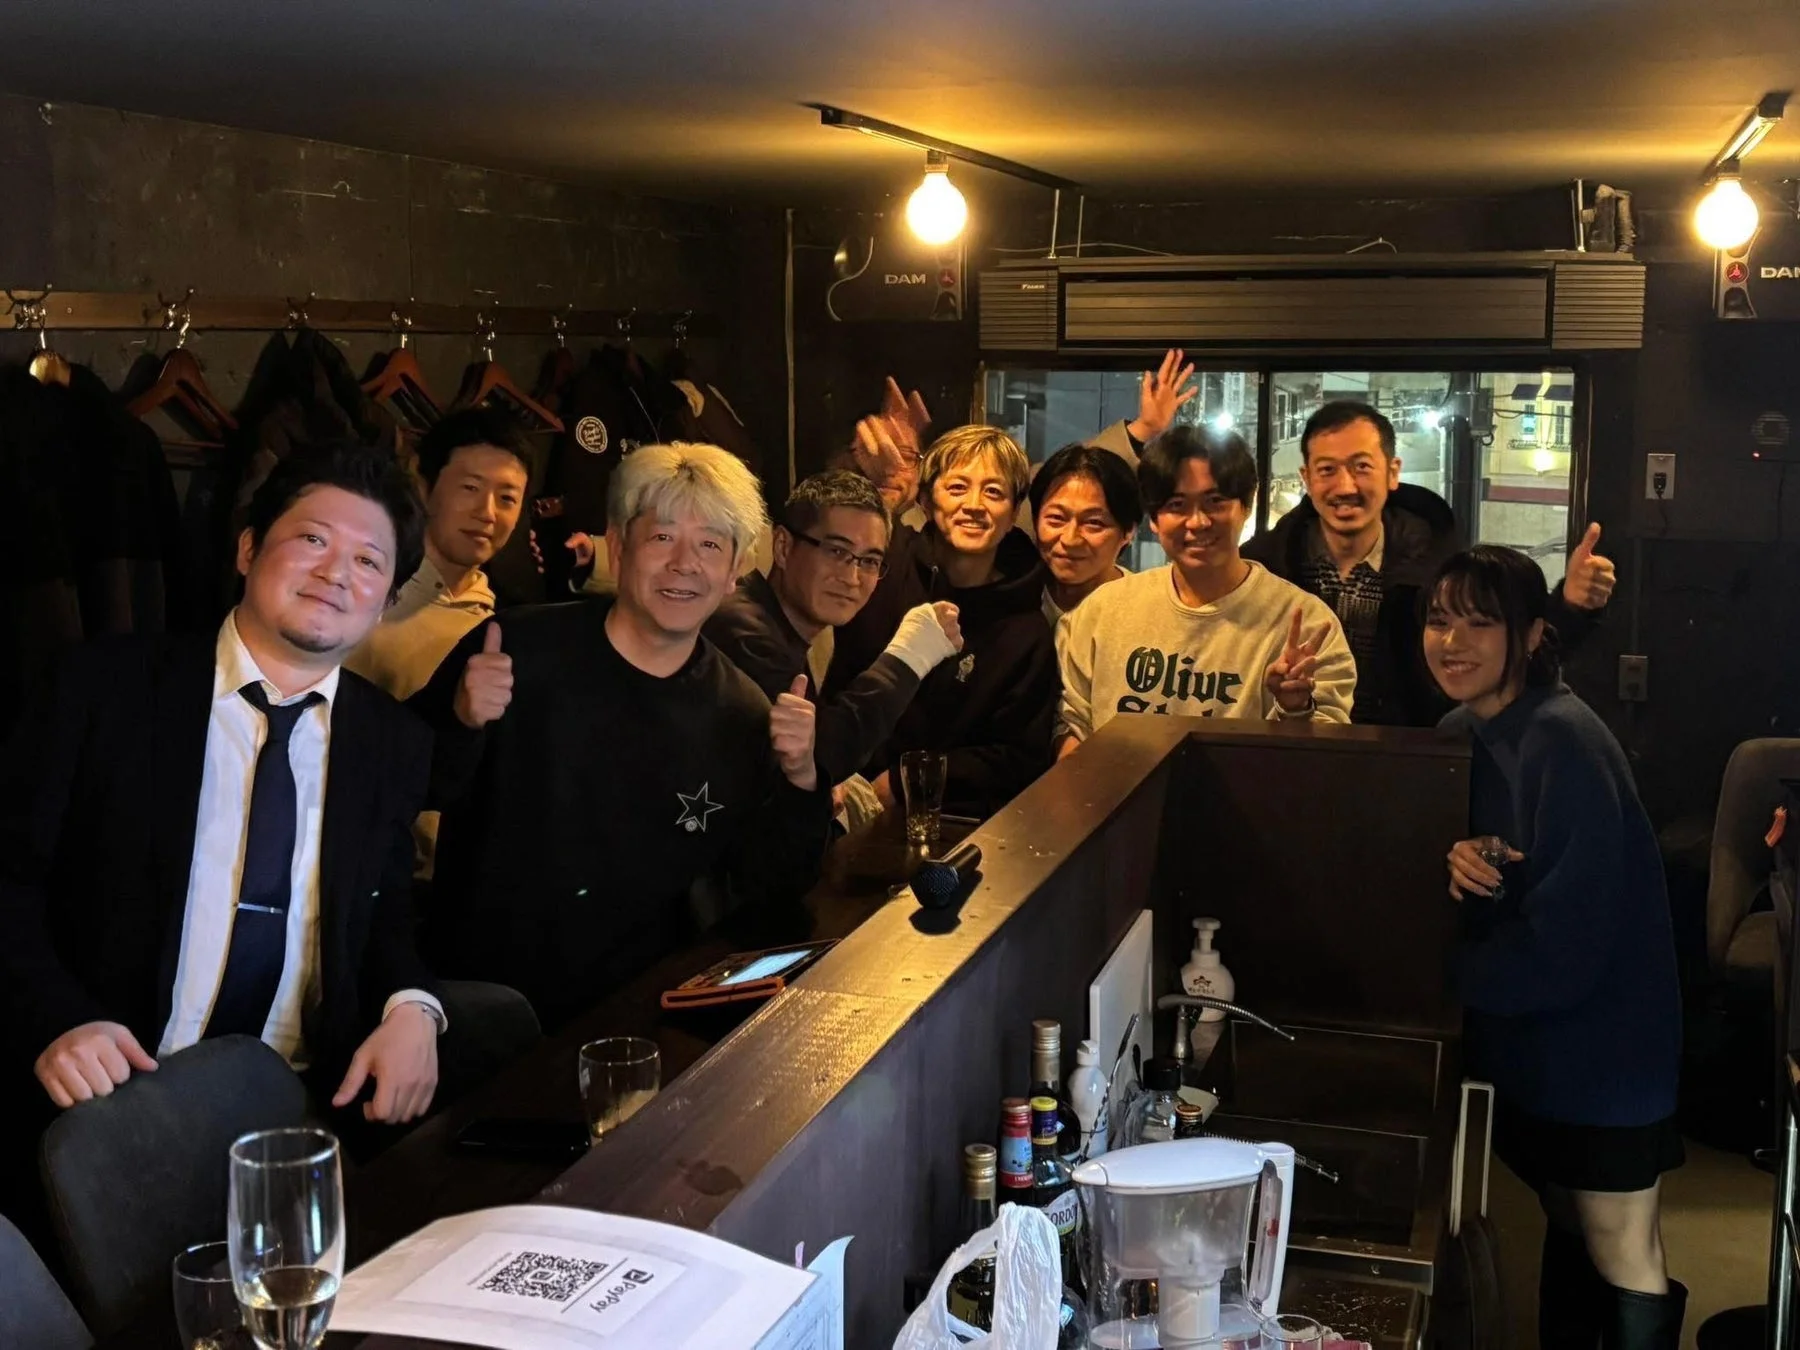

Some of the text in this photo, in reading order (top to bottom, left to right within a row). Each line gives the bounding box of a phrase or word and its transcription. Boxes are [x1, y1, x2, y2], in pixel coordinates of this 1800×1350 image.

[884, 274, 926, 284] DAM
[1126, 646, 1242, 704] Olive
[589, 1281, 637, 1313] PayPay
